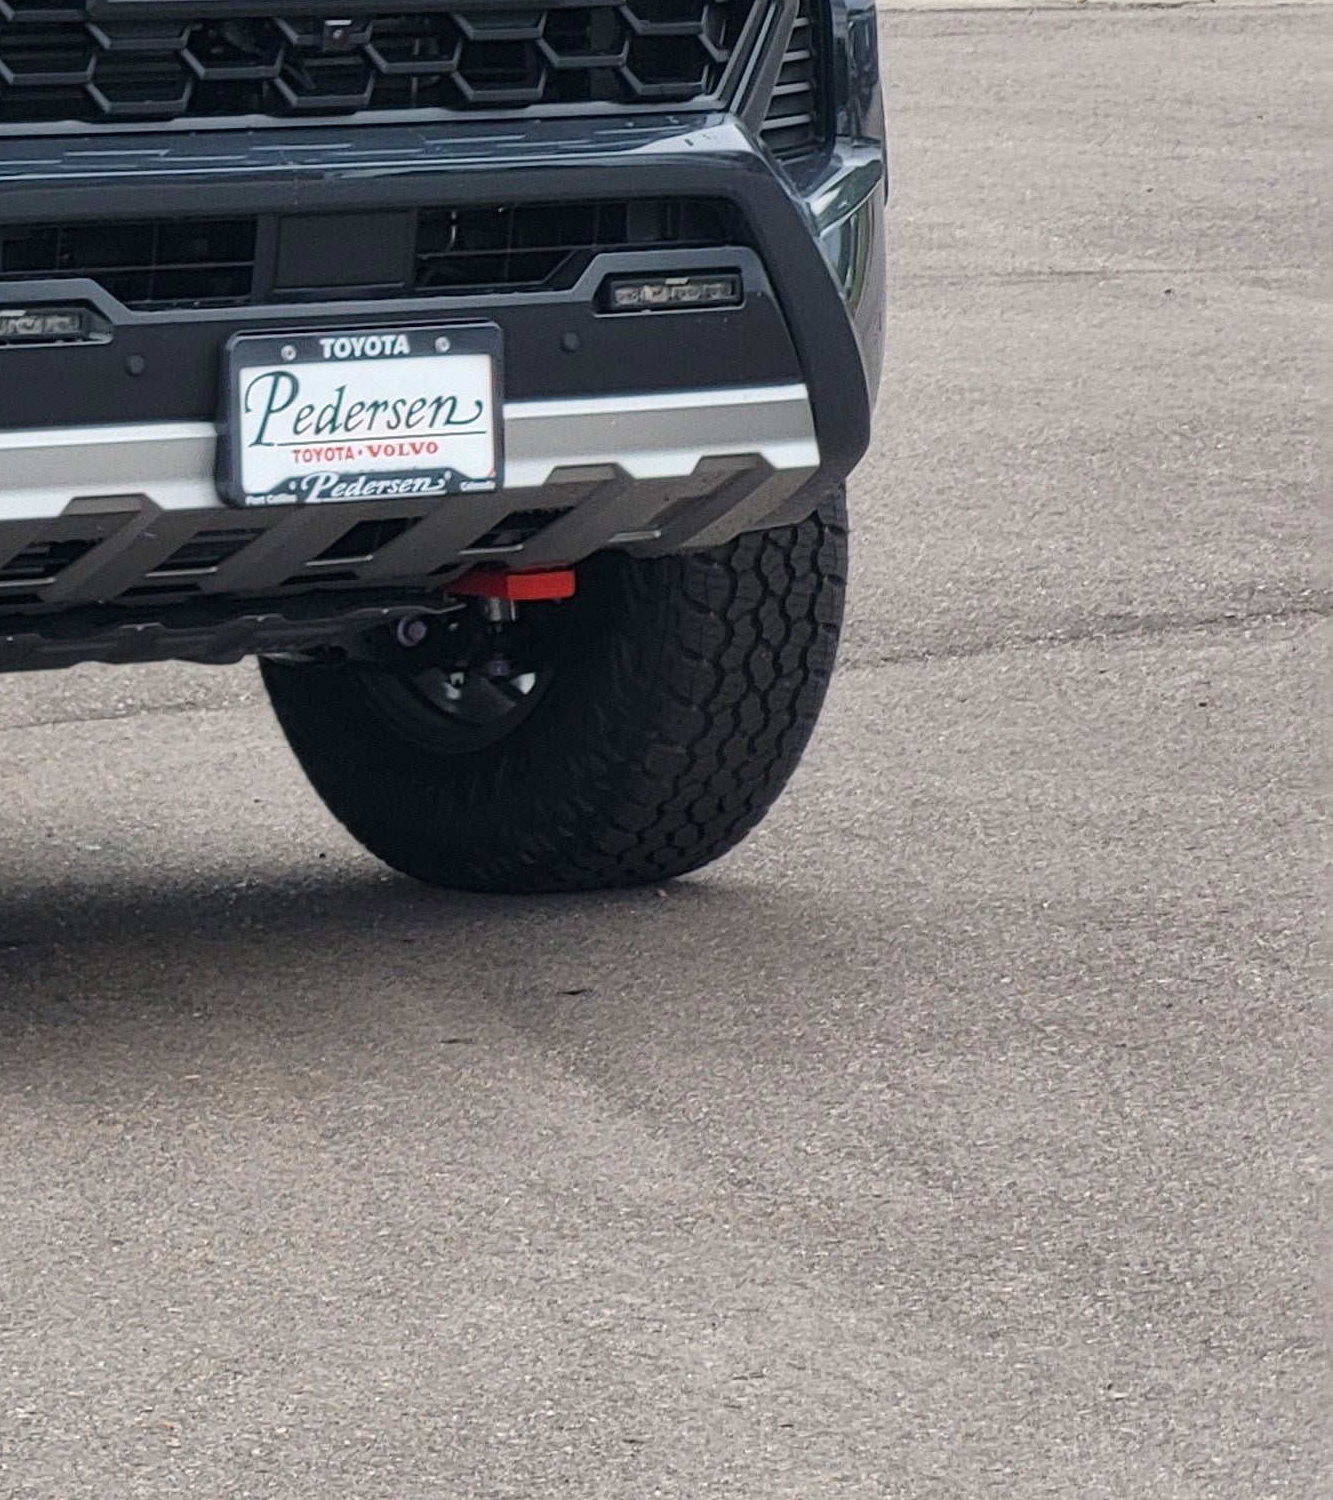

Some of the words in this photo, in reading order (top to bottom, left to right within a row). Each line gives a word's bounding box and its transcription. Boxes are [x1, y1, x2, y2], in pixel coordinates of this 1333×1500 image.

[319, 334, 410, 359] TOYOTA
[244, 370, 484, 448] Pedersen
[292, 446, 354, 463] TOYOTA
[365, 441, 439, 457] VOLVO
[301, 470, 447, 503] Pedersen
